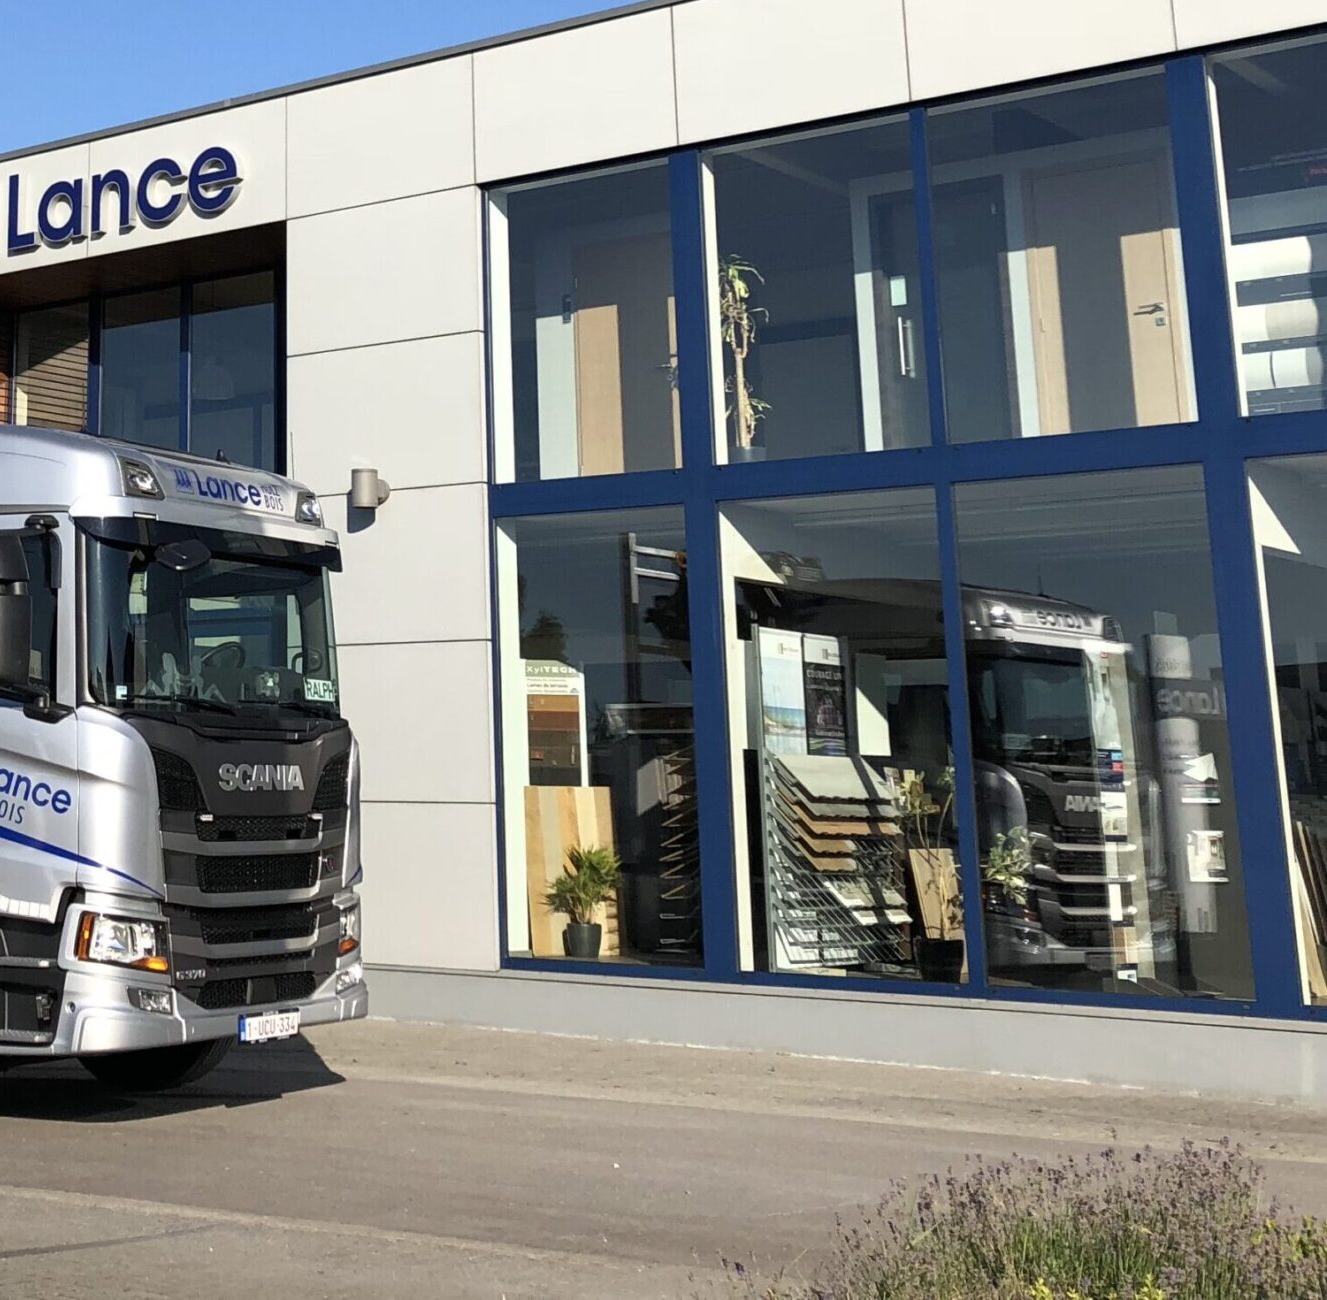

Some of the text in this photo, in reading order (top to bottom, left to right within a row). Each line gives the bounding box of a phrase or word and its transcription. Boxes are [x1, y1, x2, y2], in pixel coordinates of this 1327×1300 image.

[7, 146, 241, 254] Lance
[194, 470, 262, 506] Lance
[264, 494, 284, 512] BOIS
[305, 680, 335, 700] RALPH
[218, 762, 305, 792] SCANIA
[247, 1015, 298, 1038] 1-UCU-334
